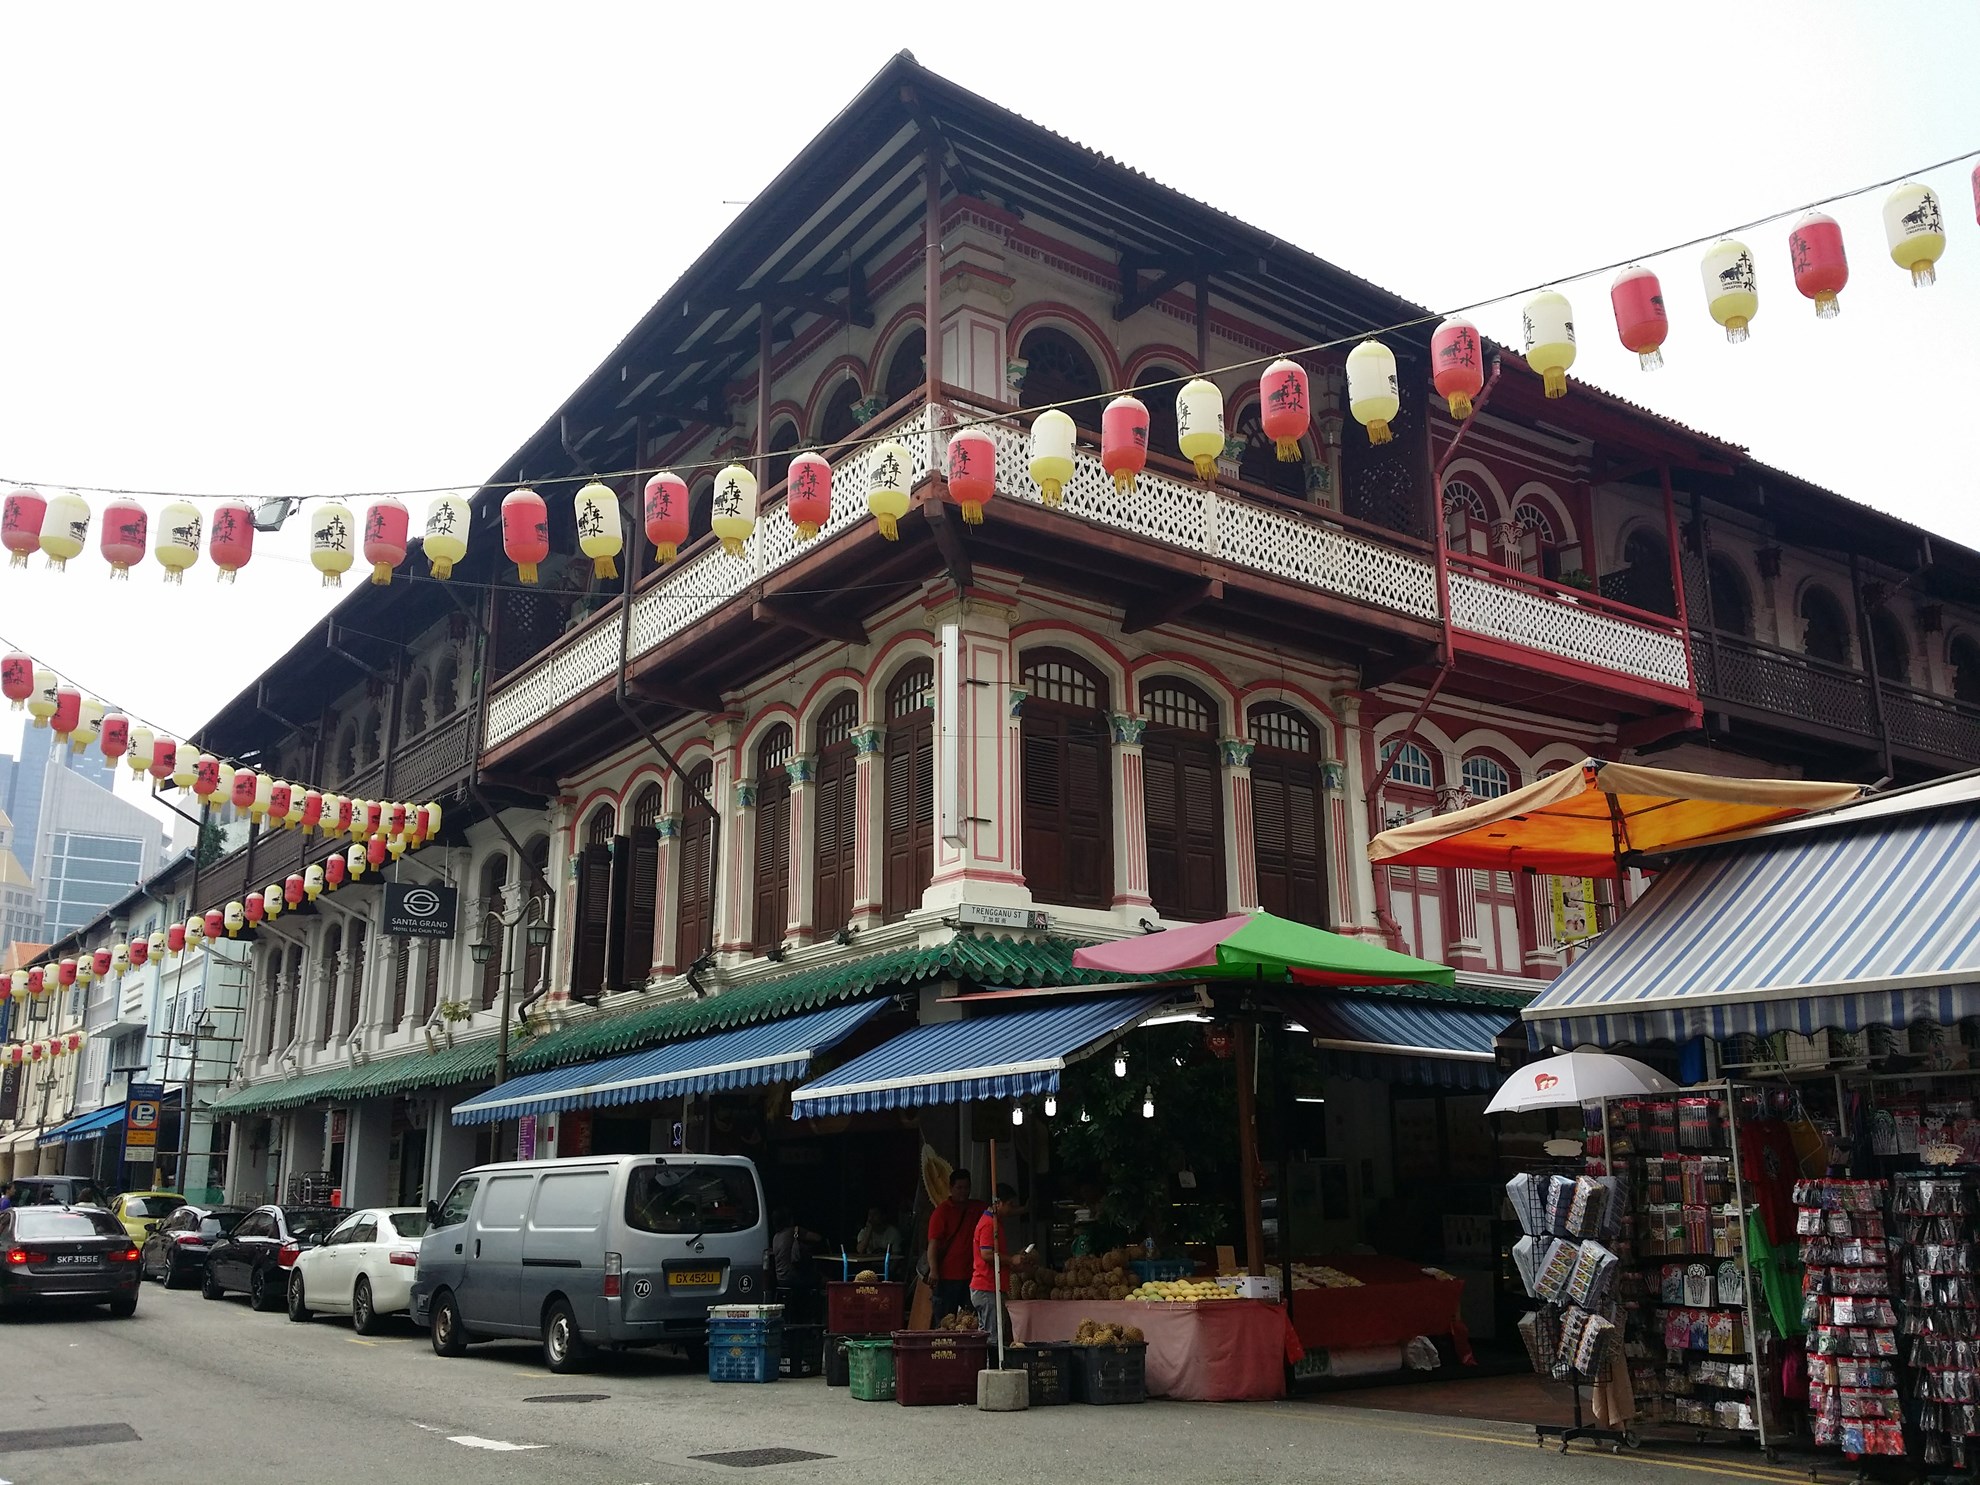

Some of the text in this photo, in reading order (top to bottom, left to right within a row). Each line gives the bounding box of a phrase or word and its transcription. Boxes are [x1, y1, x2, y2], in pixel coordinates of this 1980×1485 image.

[972, 907, 1012, 917] TRENGGANU
[391, 917, 448, 928] SANTA GRAND
[57, 1255, 98, 1264] SKF 3155E
[675, 1272, 714, 1283] GX 452U
[742, 1278, 748, 1287] 6
[637, 1282, 650, 1293] 70
